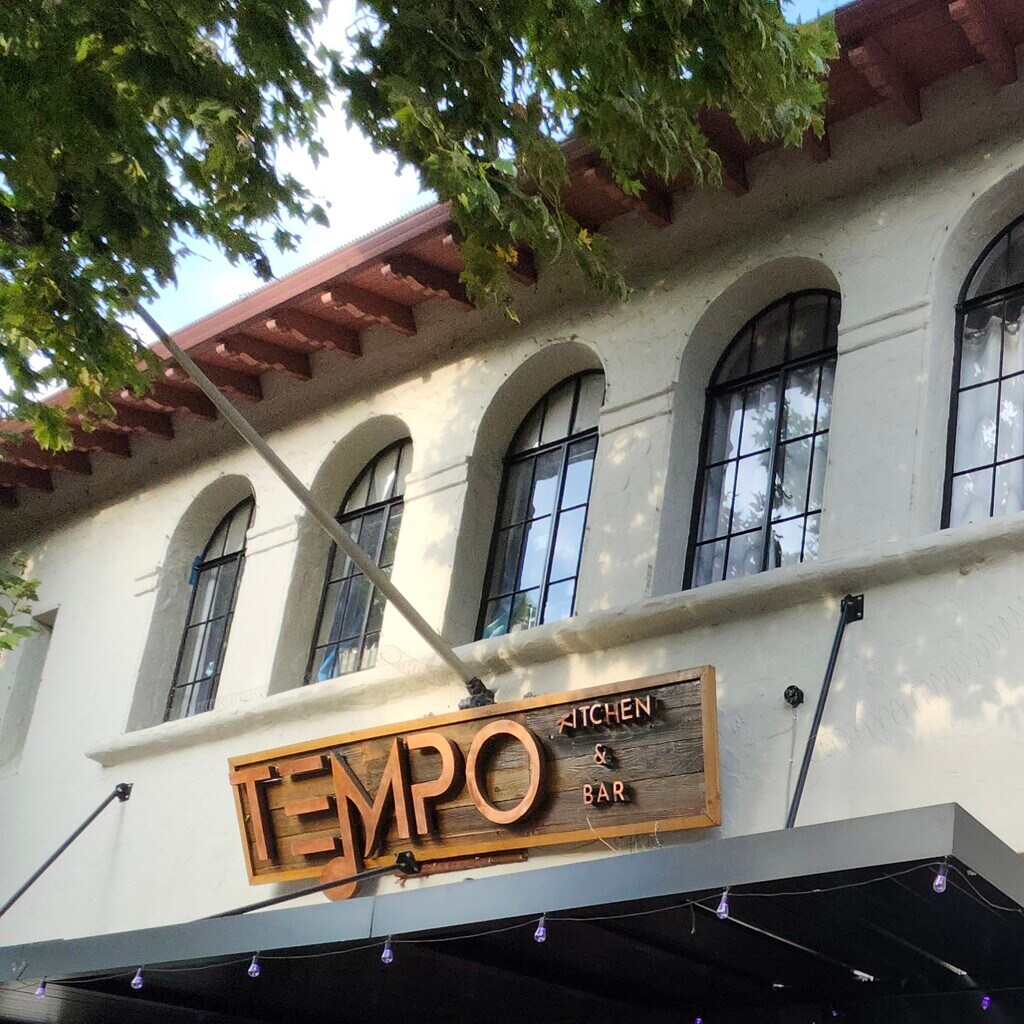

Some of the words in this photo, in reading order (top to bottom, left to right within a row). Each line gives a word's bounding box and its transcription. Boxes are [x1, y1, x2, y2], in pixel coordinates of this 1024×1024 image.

[557, 694, 653, 734] KITCHEN
[593, 743, 609, 766] &
[583, 780, 626, 805] BAR
[229, 719, 546, 901] TEMPO
